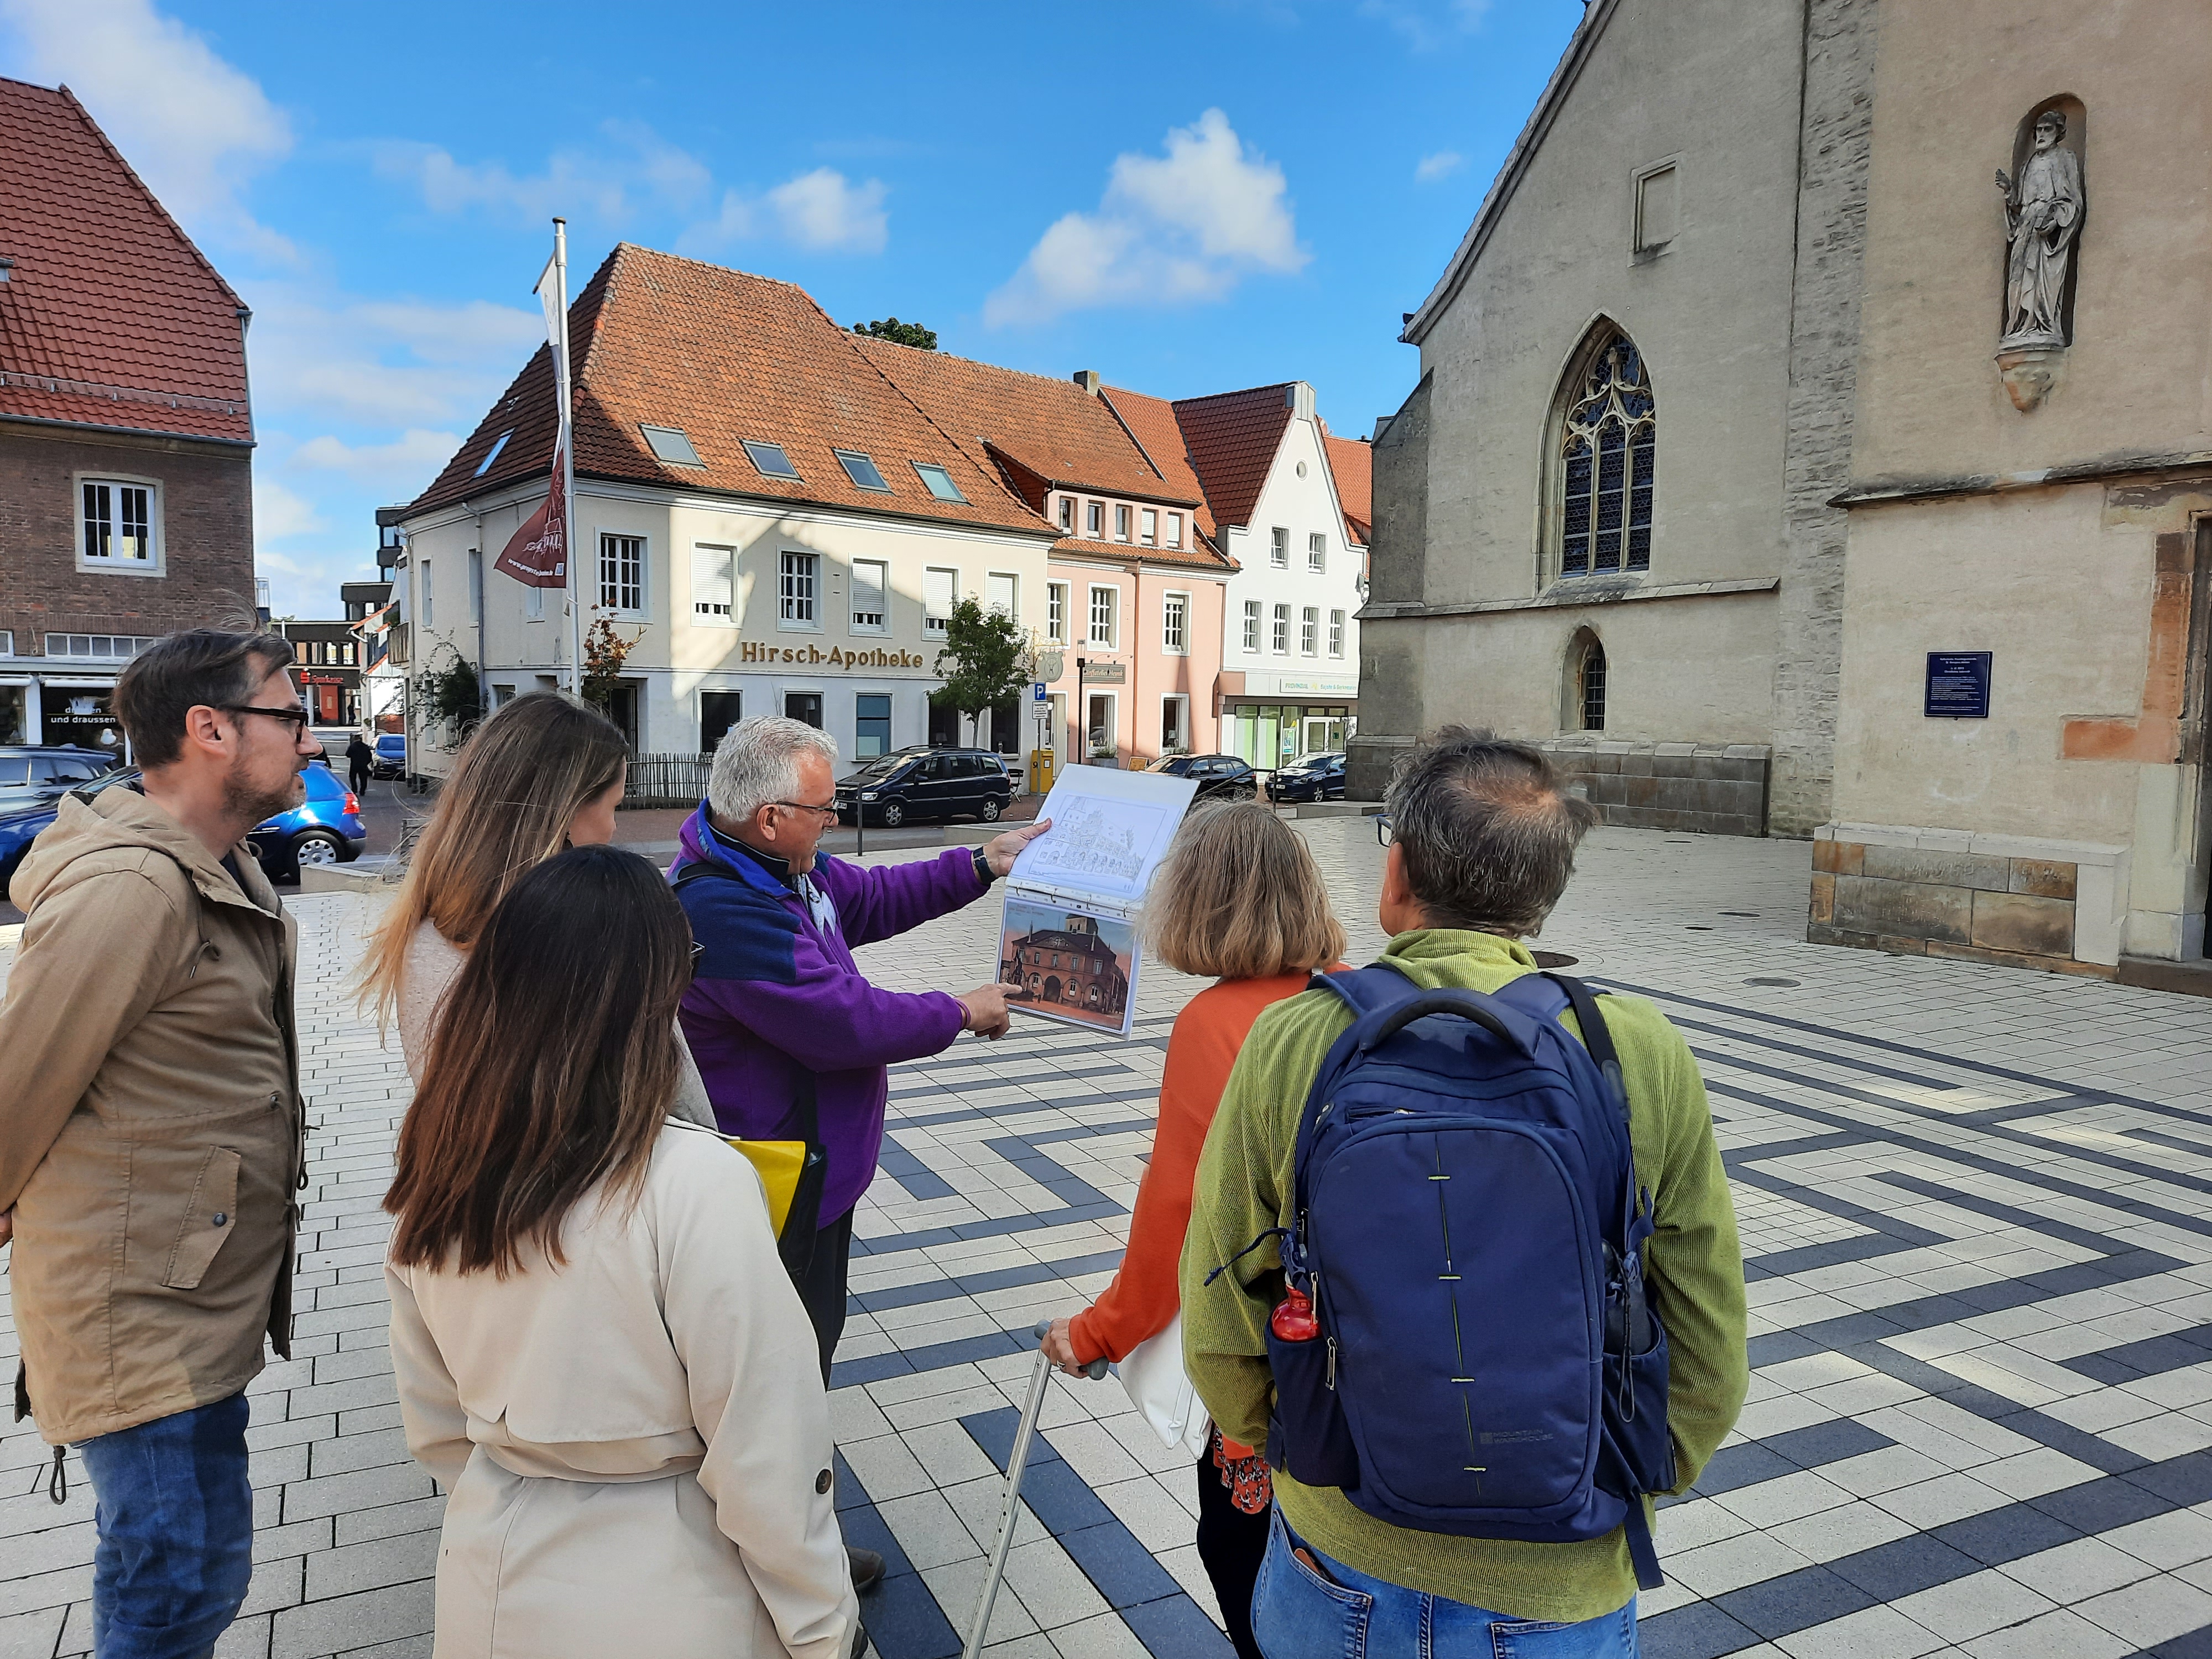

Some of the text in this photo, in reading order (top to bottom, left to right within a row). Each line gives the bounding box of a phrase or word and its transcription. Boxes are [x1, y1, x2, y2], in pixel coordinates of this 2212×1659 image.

[741, 641, 923, 670] Hirsch-Apotheke
[1037, 685, 1044, 698] P
[1493, 1429, 1543, 1437] MOUNTAIN
[1494, 1433, 1553, 1444] WAREHOUSE
